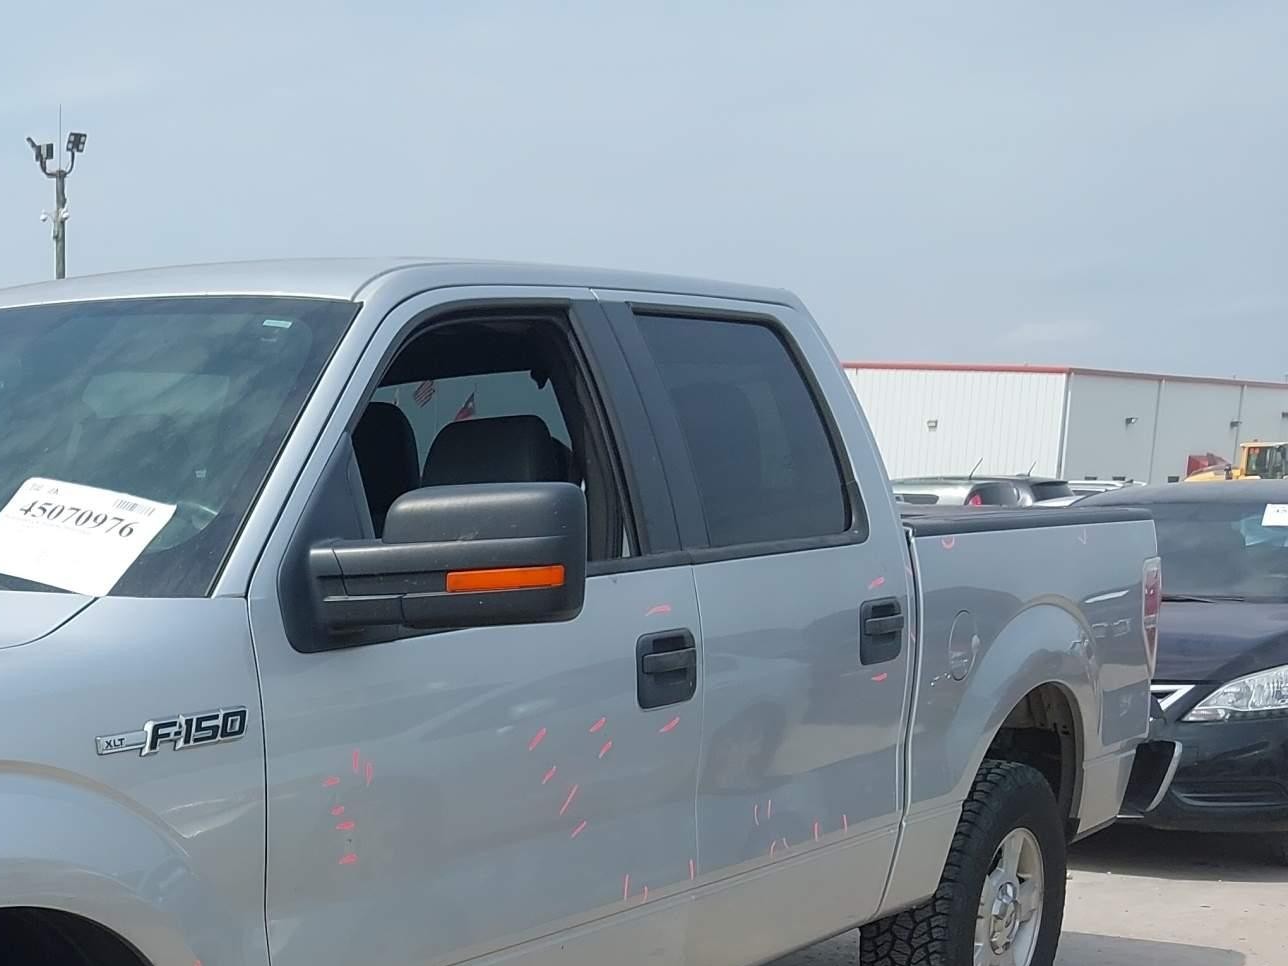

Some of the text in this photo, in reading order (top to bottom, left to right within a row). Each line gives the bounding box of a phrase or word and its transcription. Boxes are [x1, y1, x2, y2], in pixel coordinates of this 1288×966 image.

[19, 500, 140, 538] 45070976
[105, 706, 248, 754] XLT F-150
